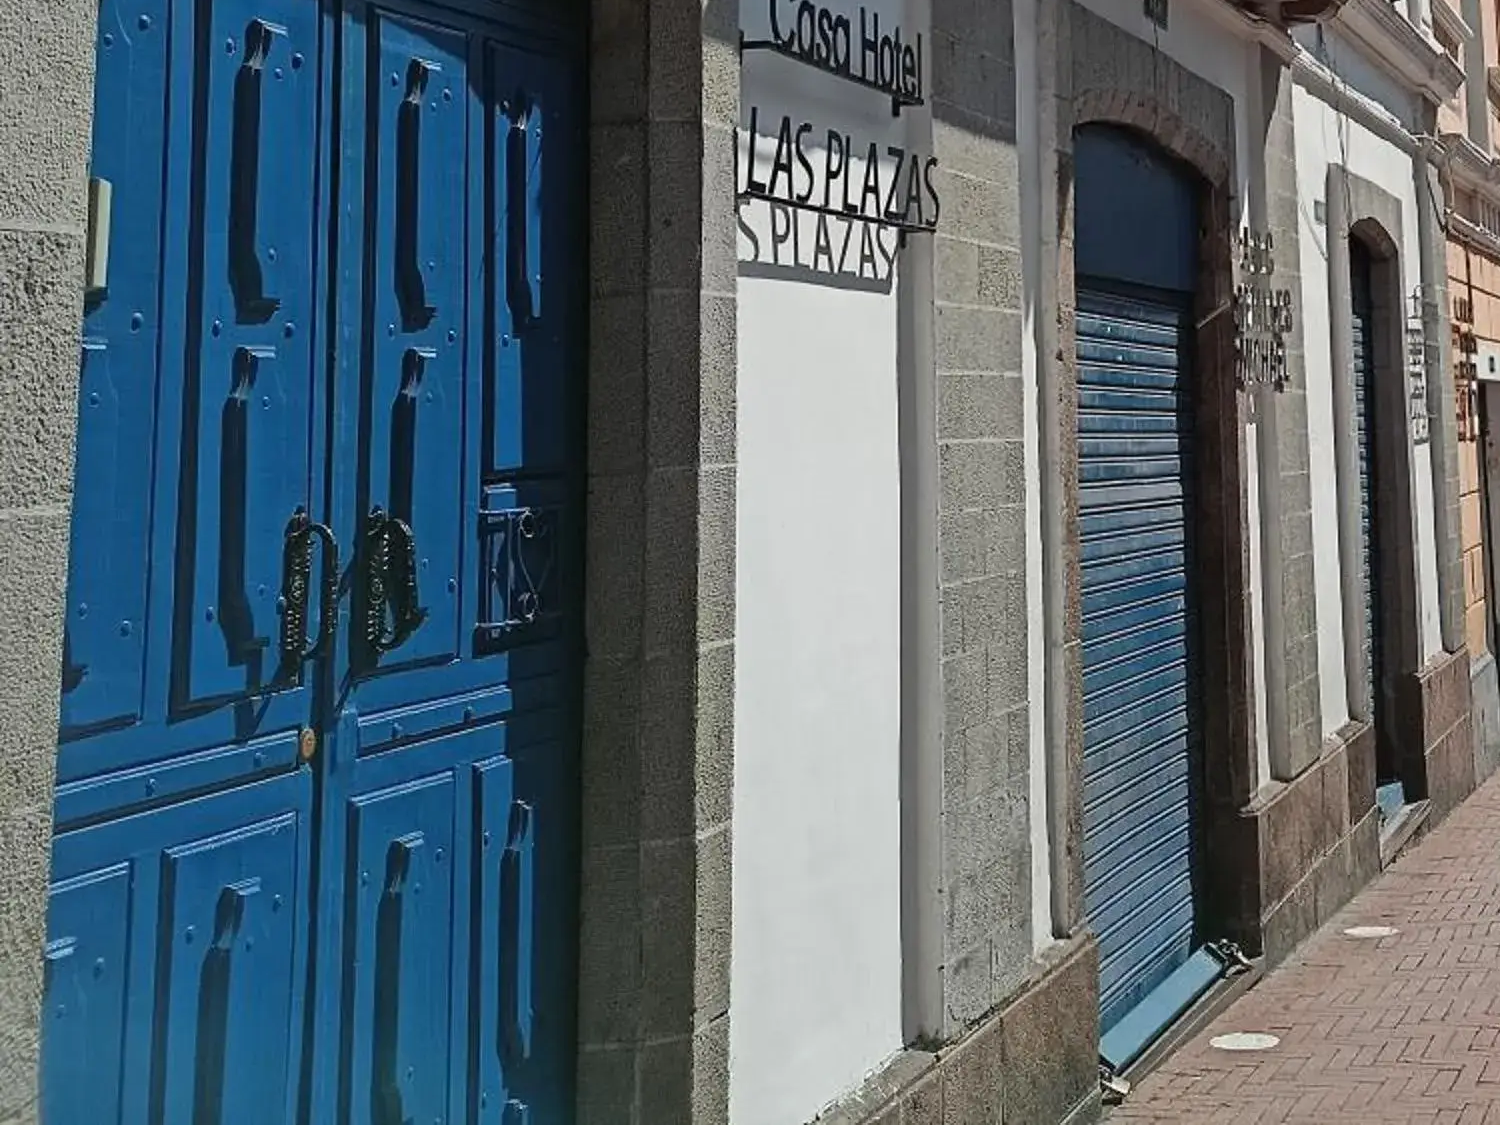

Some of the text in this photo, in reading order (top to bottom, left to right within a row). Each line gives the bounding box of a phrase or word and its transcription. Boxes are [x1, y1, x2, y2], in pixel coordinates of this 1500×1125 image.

[860, 6, 923, 101] Hotel
[747, 106, 940, 225] LAS PLAZAS
